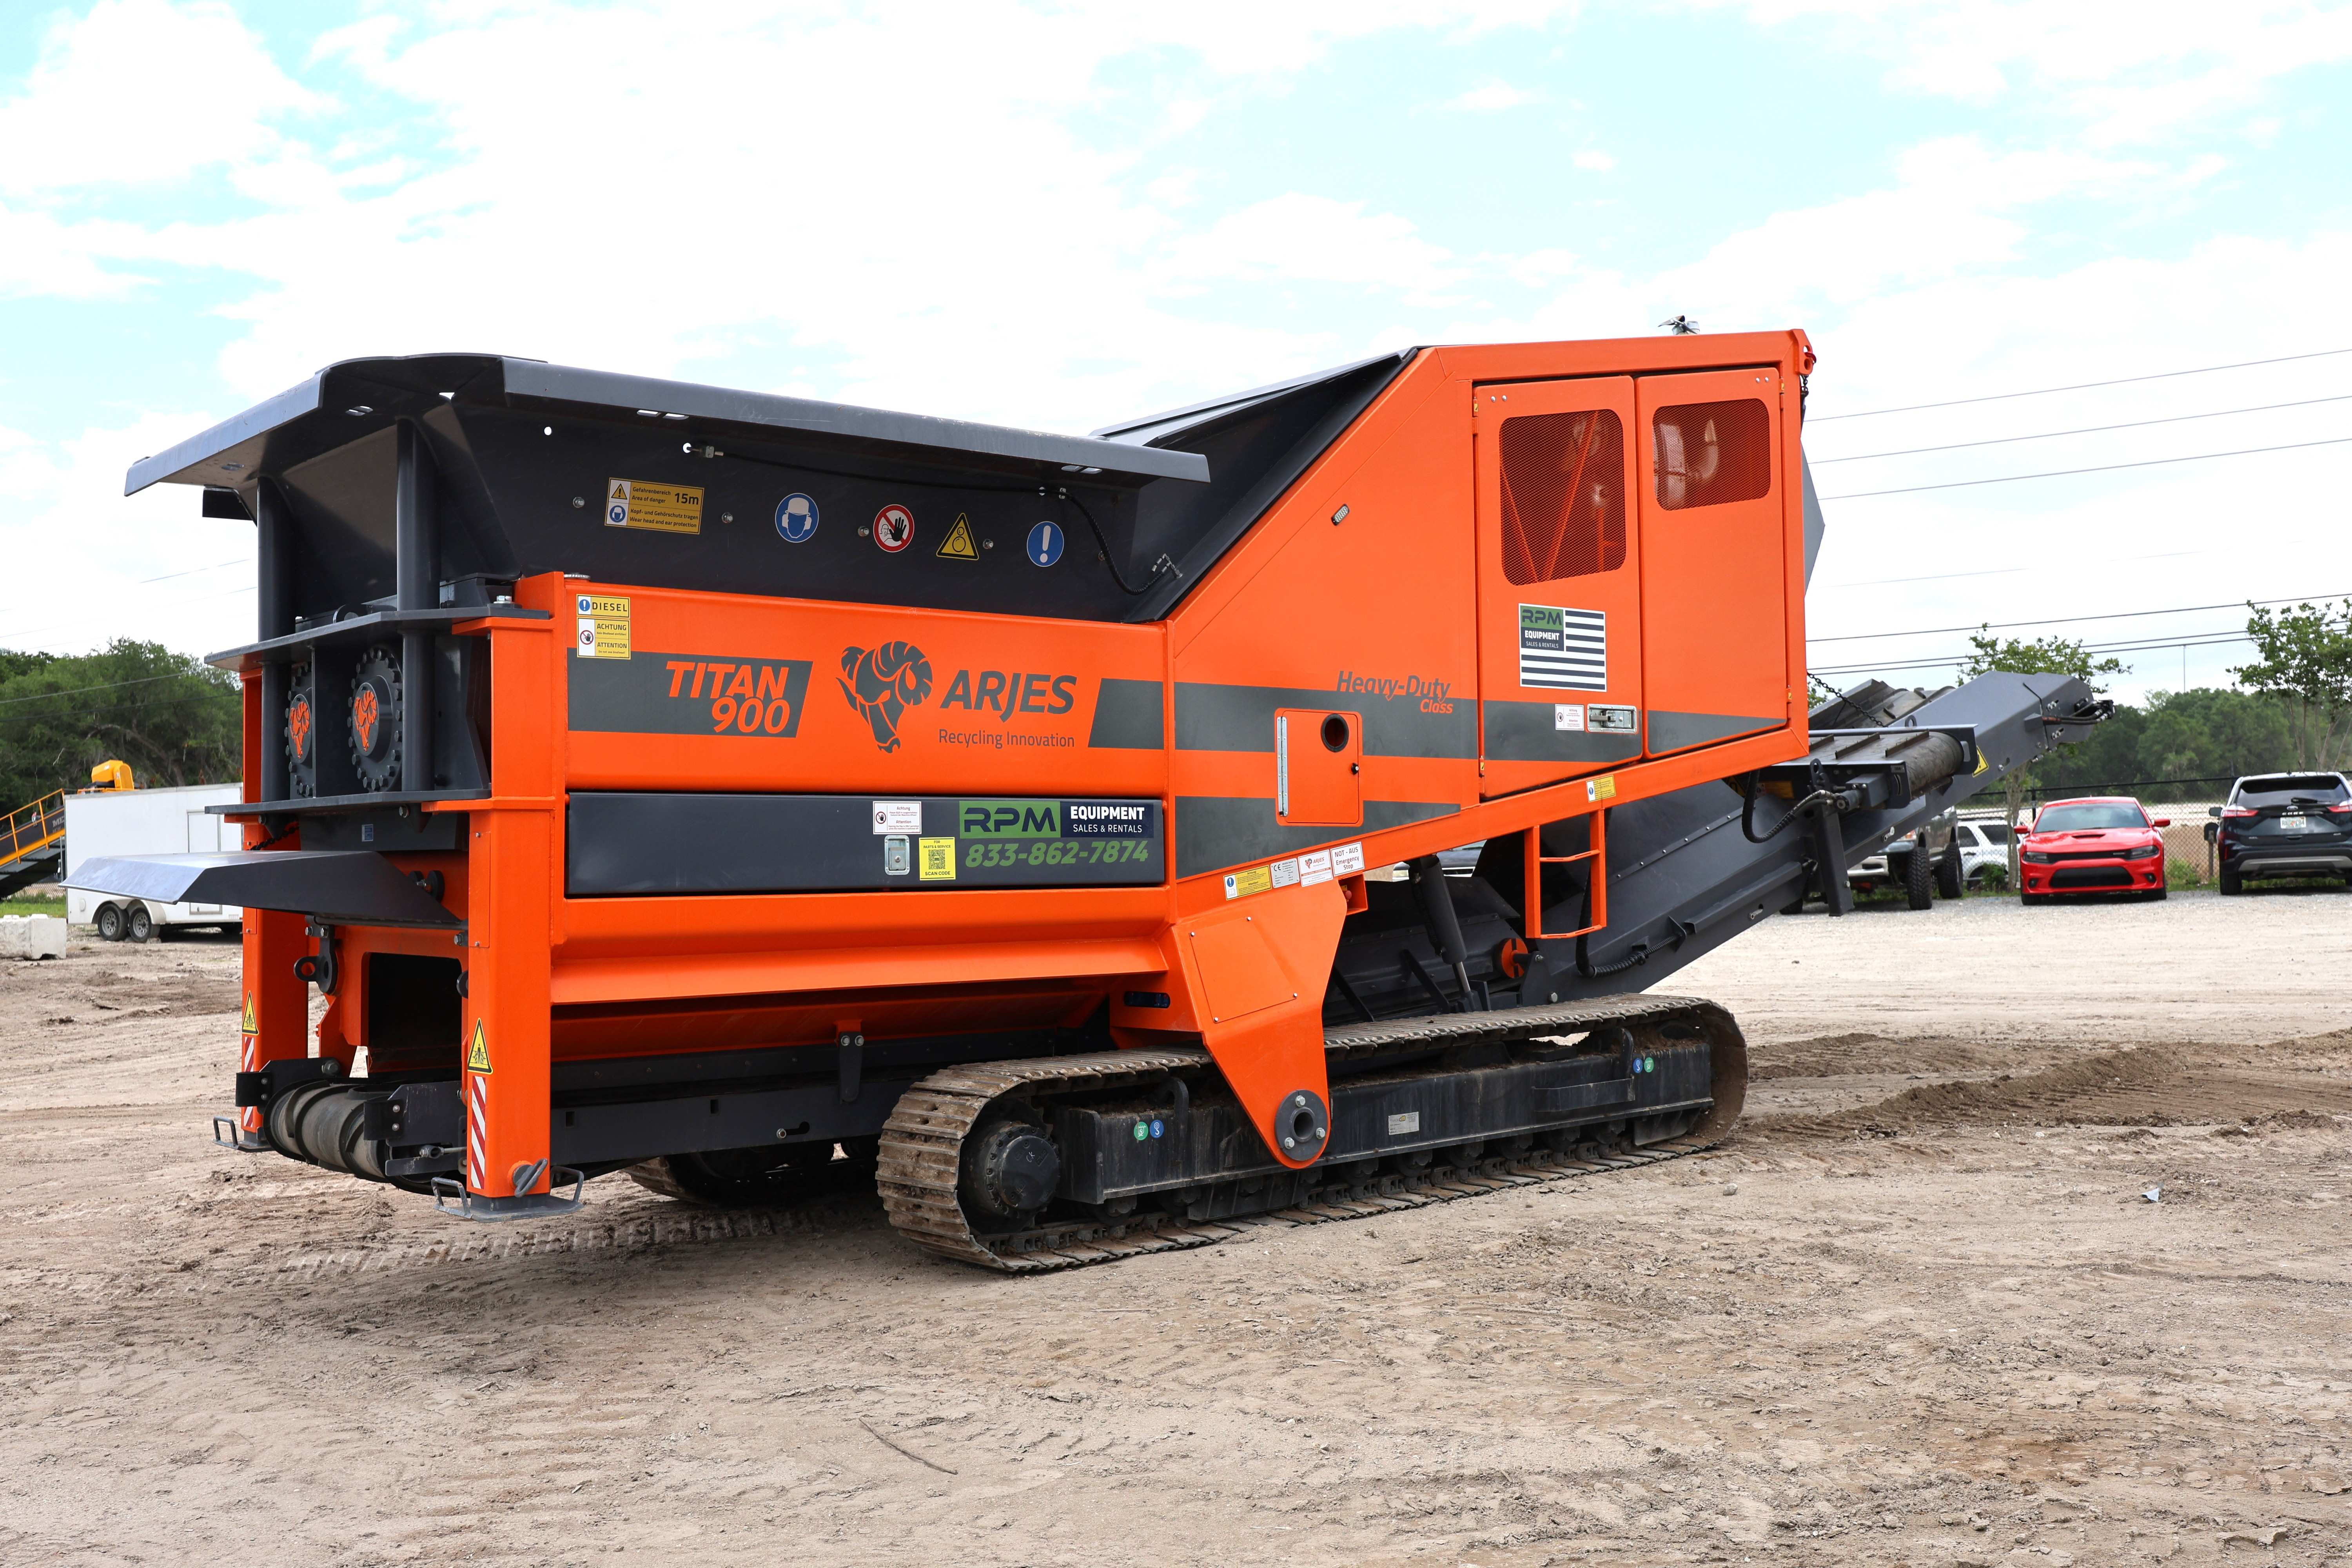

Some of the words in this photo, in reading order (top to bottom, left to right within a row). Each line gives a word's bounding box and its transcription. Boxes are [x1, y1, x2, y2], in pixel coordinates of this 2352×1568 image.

[633, 487, 671, 495] Gefahrenbereich
[675, 492, 699, 505] 15m
[592, 602, 627, 612] DIESEL
[1522, 609, 1562, 626] RPM
[1524, 630, 1559, 640] EQUIPMENT
[666, 661, 789, 701] TITAN
[1336, 670, 1451, 704] Heavy-Duty
[939, 670, 1077, 723] ARJES
[1420, 699, 1454, 713] Class
[712, 697, 790, 734] 900
[939, 728, 1003, 750] Recycling
[1007, 731, 1075, 748] Innovation
[964, 807, 1057, 833] RPM
[1070, 806, 1145, 821] EQUIPMENT
[1073, 824, 1098, 833] SALES
[1108, 824, 1142, 833] RENTALS
[965, 840, 1149, 867] 833-862-7874
[1336, 856, 1359, 865] Emergency
